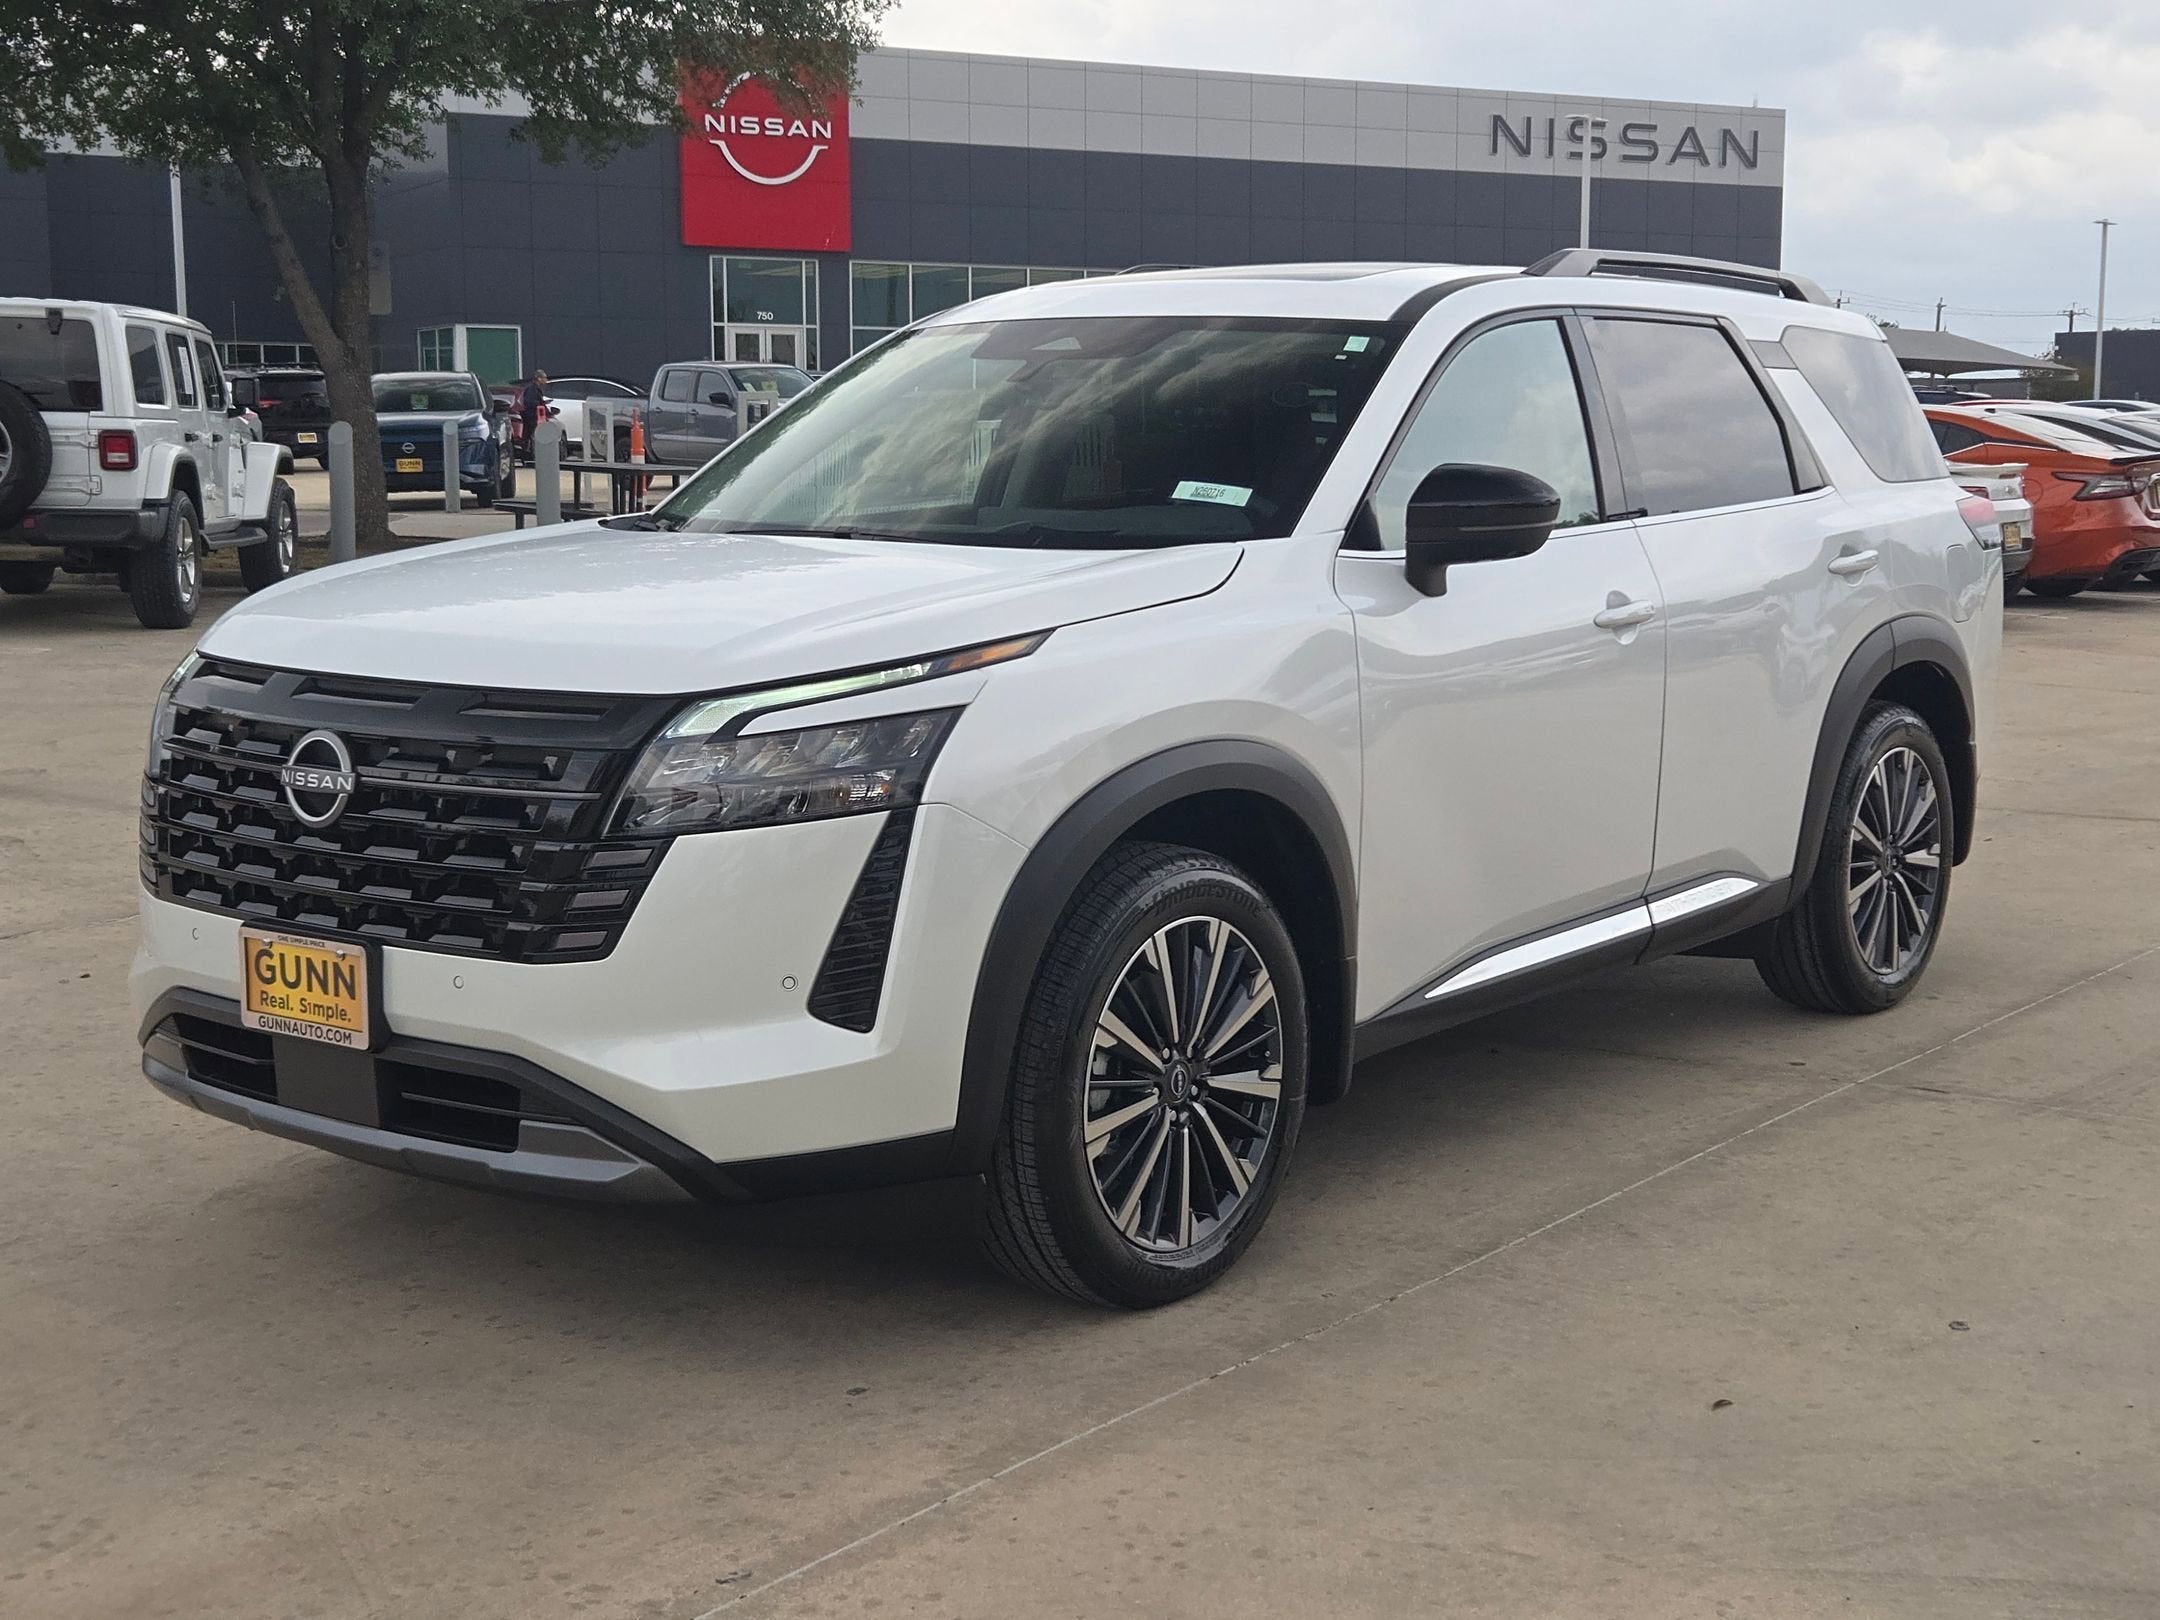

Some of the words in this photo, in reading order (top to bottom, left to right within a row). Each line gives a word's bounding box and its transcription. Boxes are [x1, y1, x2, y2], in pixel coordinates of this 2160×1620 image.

[704, 114, 832, 139] NISSAN
[1490, 114, 1759, 169] NISSAN
[757, 311, 774, 320] 750
[281, 769, 352, 791] NISSAN
[254, 948, 356, 1000] GUNN
[260, 990, 294, 1011] Real.
[258, 1015, 352, 1045] GUNNAUTO.COM
